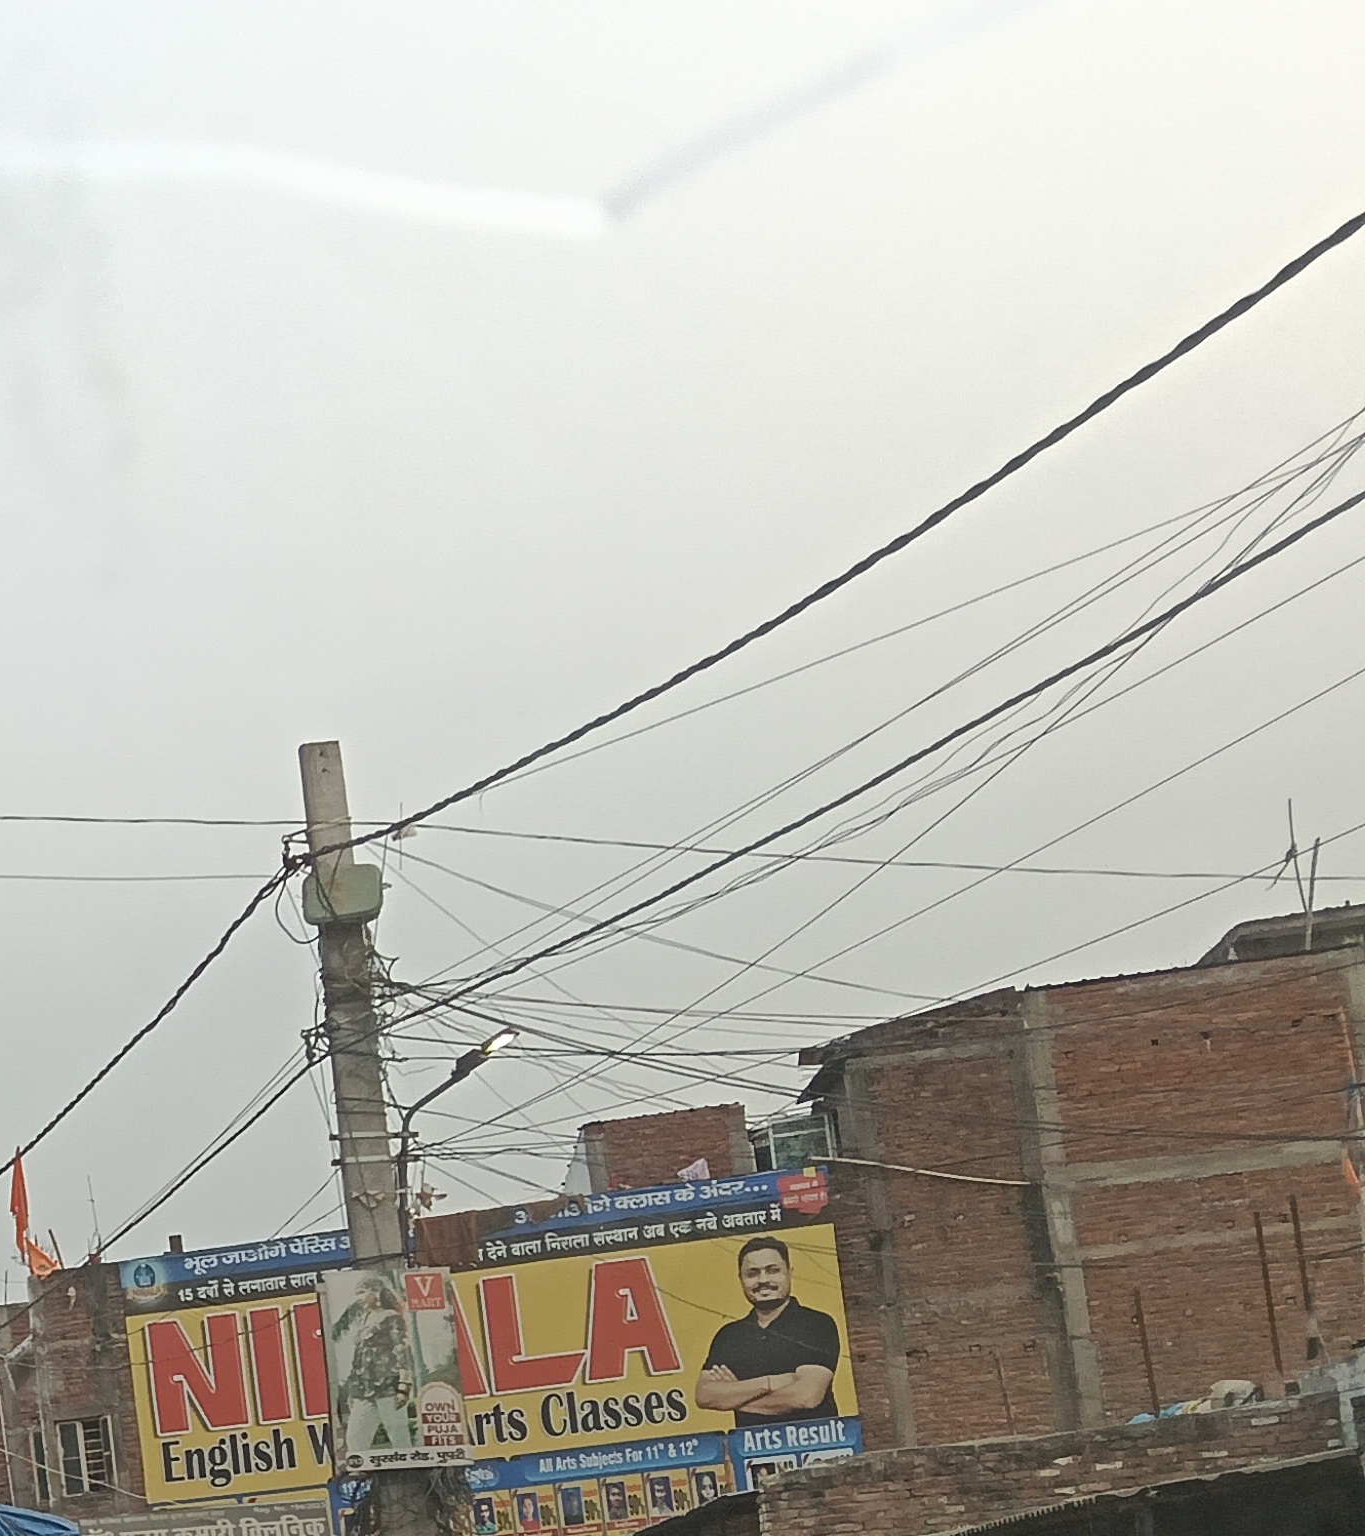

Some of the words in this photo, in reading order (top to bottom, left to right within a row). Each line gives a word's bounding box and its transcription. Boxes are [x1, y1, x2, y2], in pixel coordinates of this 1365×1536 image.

[511, 1238, 542, 1257] वाला
[545, 1231, 591, 1253] निराला
[643, 1224, 666, 1240] अब
[669, 1219, 693, 1238] एक
[722, 1210, 768, 1229] अवतार
[184, 1255, 218, 1275] भूल
[177, 1288, 194, 1302] 15
[414, 1276, 434, 1298] V
[424, 1398, 456, 1412] OWN
[427, 1413, 460, 1423] YOUR
[427, 1422, 459, 1434] PUJA
[162, 1426, 298, 1489] English
[540, 1389, 688, 1437] Classes
[431, 1435, 456, 1446] FITS
[743, 1427, 783, 1452] Arts
[785, 1420, 847, 1448] Result
[538, 1456, 553, 1474] All
[555, 1453, 578, 1471] Arts
[579, 1448, 624, 1470] Subjects
[626, 1447, 644, 1463] For
[668, 1443, 677, 1458] &
